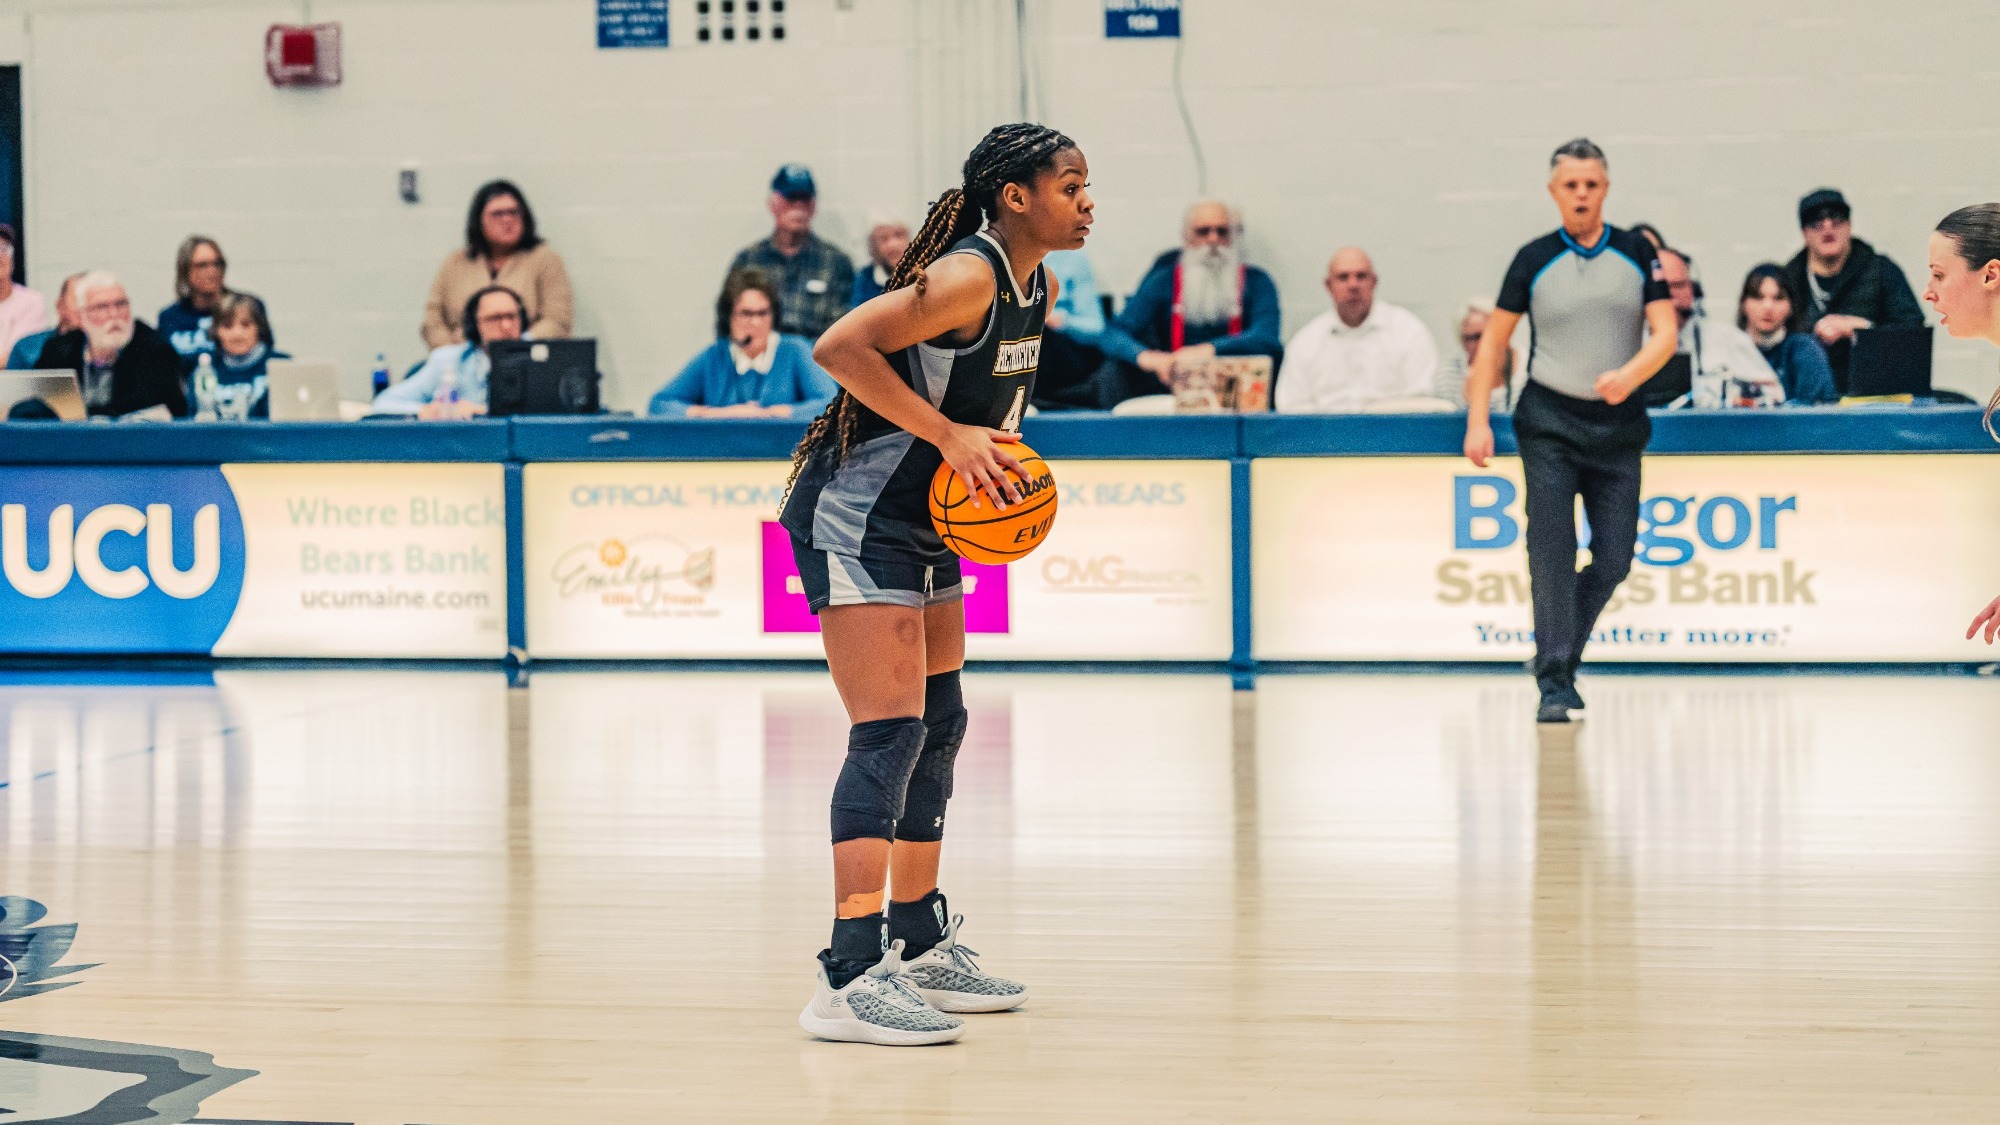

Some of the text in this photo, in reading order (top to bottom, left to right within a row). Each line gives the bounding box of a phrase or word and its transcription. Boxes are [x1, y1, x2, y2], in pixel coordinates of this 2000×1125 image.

[571, 484, 686, 507] OFFICIAL
[1095, 482, 1186, 505] BEARS
[287, 497, 504, 527] Where Black
[1453, 475, 1796, 567] Bgor
[3, 503, 220, 599] UCU
[300, 545, 490, 574] Bears Bank
[551, 541, 668, 609] Emily
[1041, 555, 1123, 585] CMG
[301, 585, 490, 611] ucumaine.com
[1436, 560, 1817, 612] Savs Bank
[1588, 625, 1671, 645] atter
